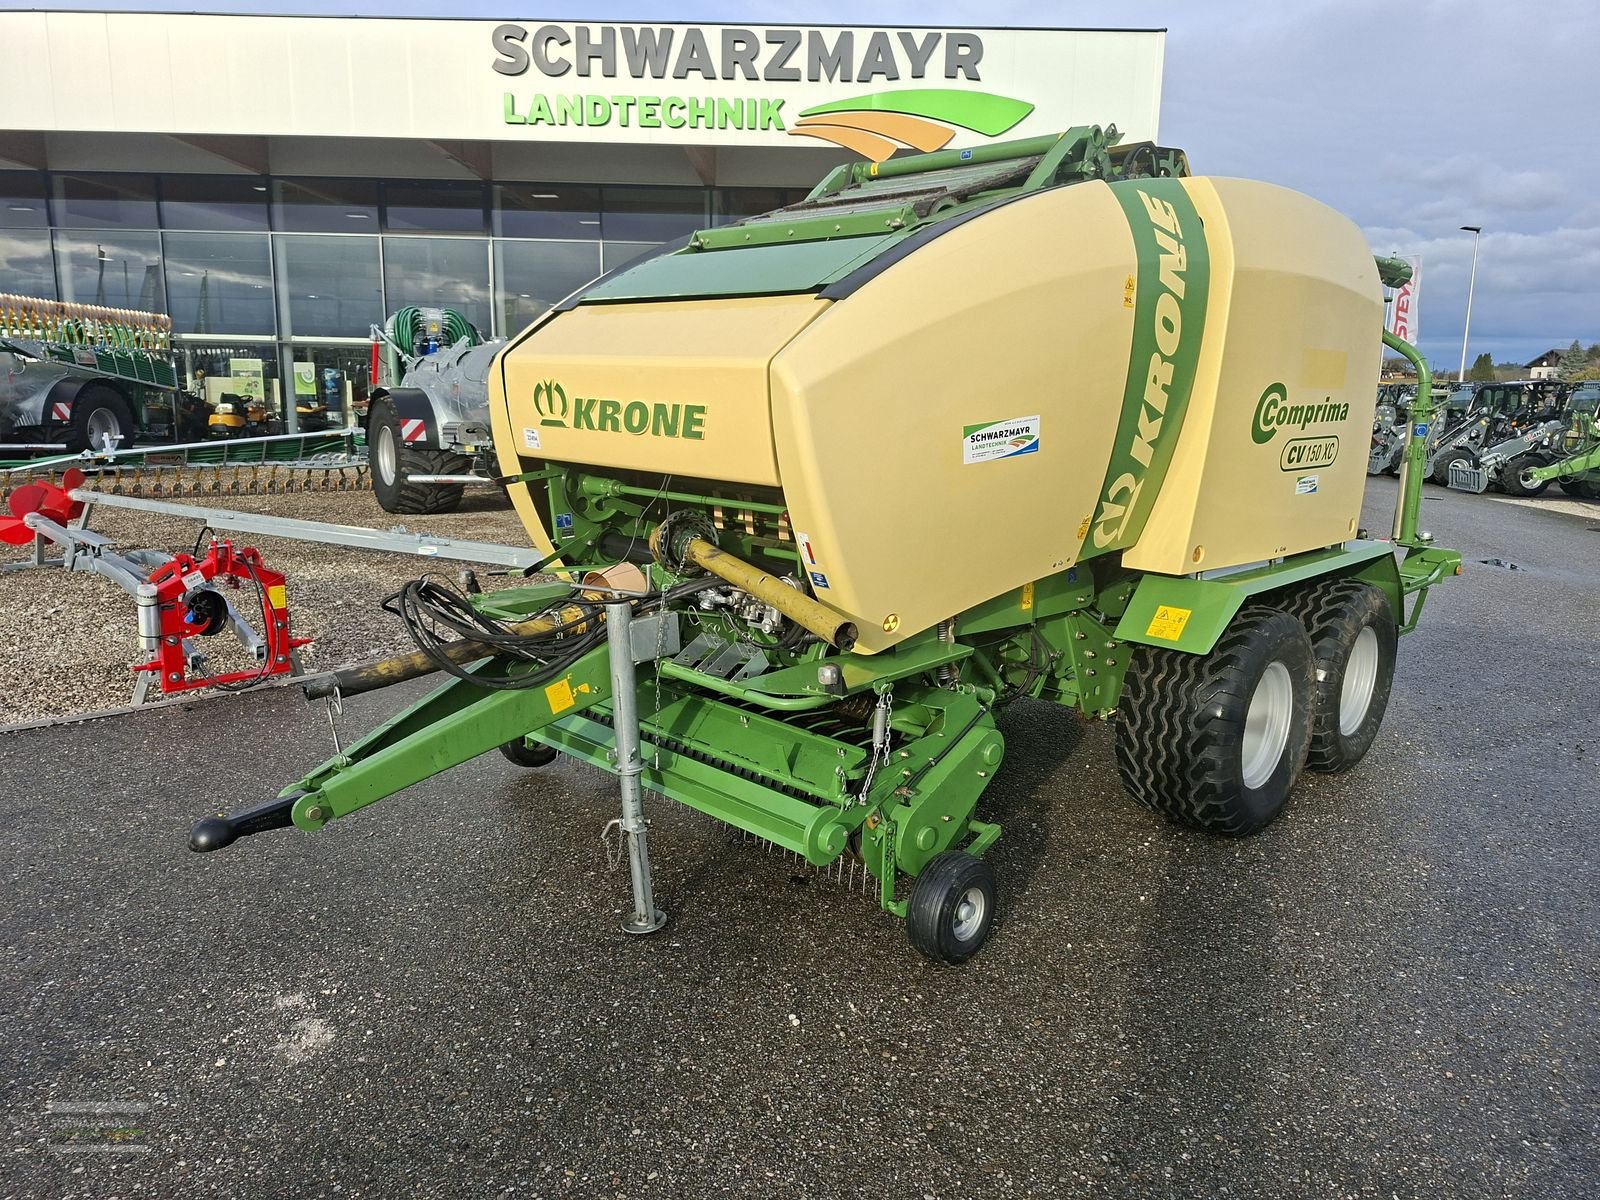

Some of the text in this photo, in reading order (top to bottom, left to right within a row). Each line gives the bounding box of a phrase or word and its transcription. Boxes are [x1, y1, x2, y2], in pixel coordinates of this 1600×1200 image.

[491, 24, 984, 83] SCHWARZMAYR
[503, 92, 785, 130] LANDTECHNIK
[1130, 189, 1187, 469] KRONE
[1393, 280, 1412, 340] STEY
[573, 398, 707, 440] KRONE
[970, 426, 1030, 443] SCHWARZMAYR
[972, 440, 1007, 450] LANDTECHNIK
[1287, 442, 1335, 464] CV 150 XC
